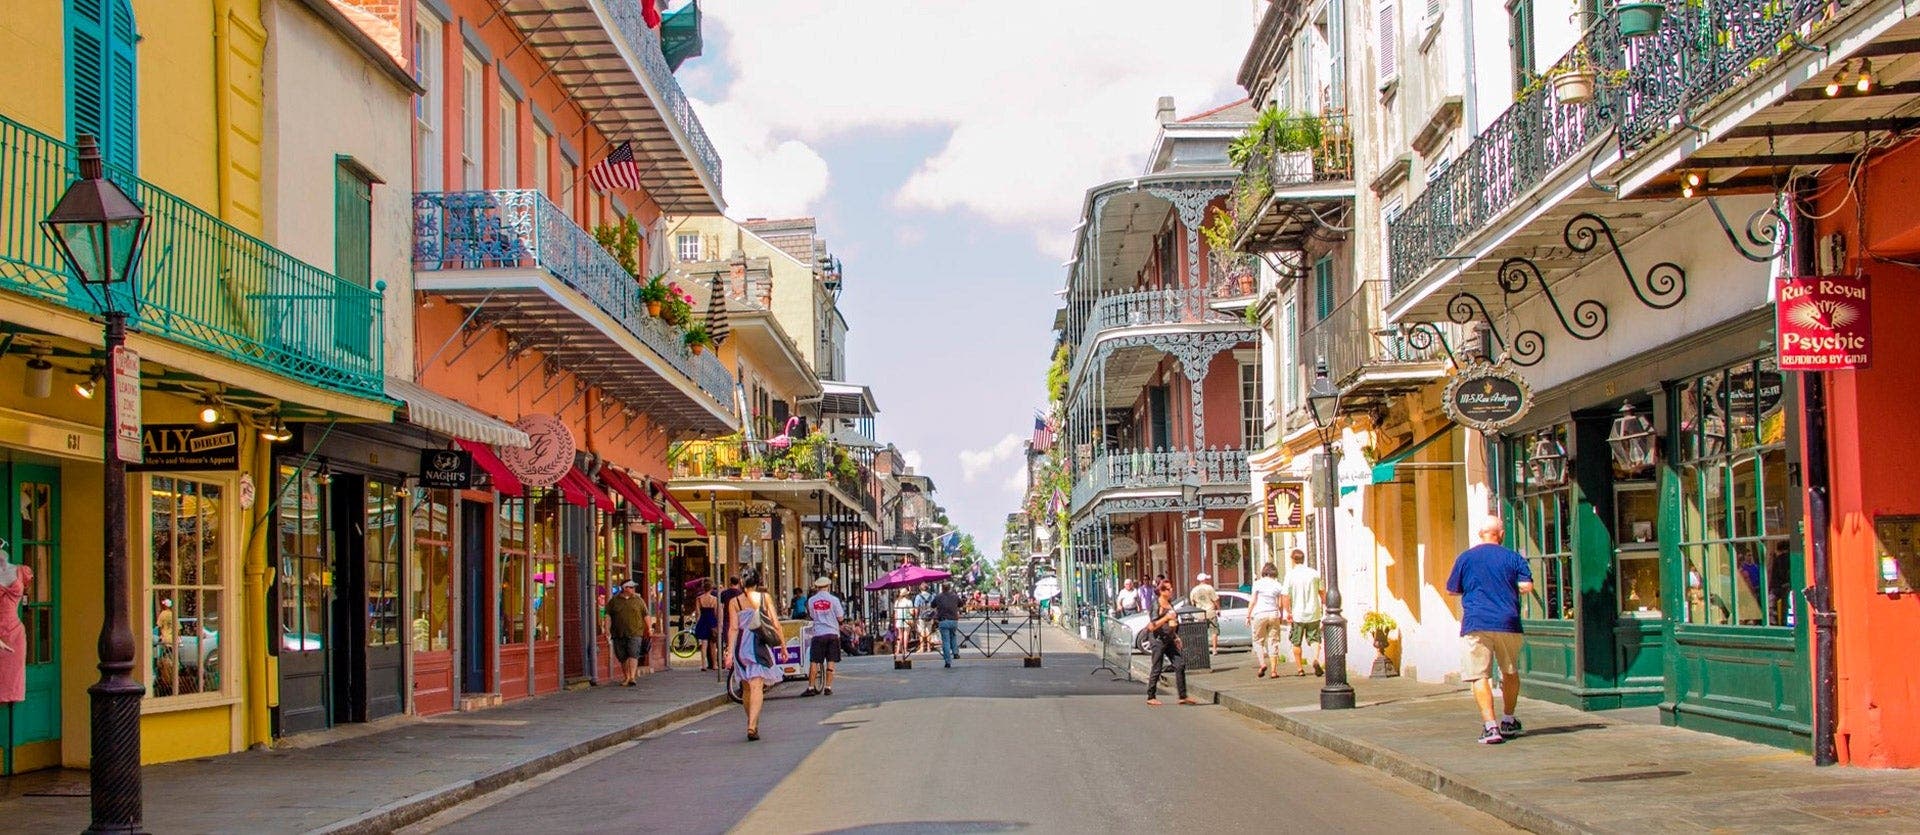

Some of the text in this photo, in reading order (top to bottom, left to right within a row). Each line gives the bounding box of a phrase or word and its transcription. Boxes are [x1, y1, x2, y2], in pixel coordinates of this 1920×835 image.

[1781, 280, 1866, 302] Rue Royal
[1782, 332, 1865, 352] Psychic
[1782, 354, 1867, 365] READINGS BY GINA
[67, 433, 81, 450] 631
[143, 429, 233, 453] ALY DIRECT
[209, 456, 235, 466] Apparel
[425, 470, 466, 482] NAGHI'S
